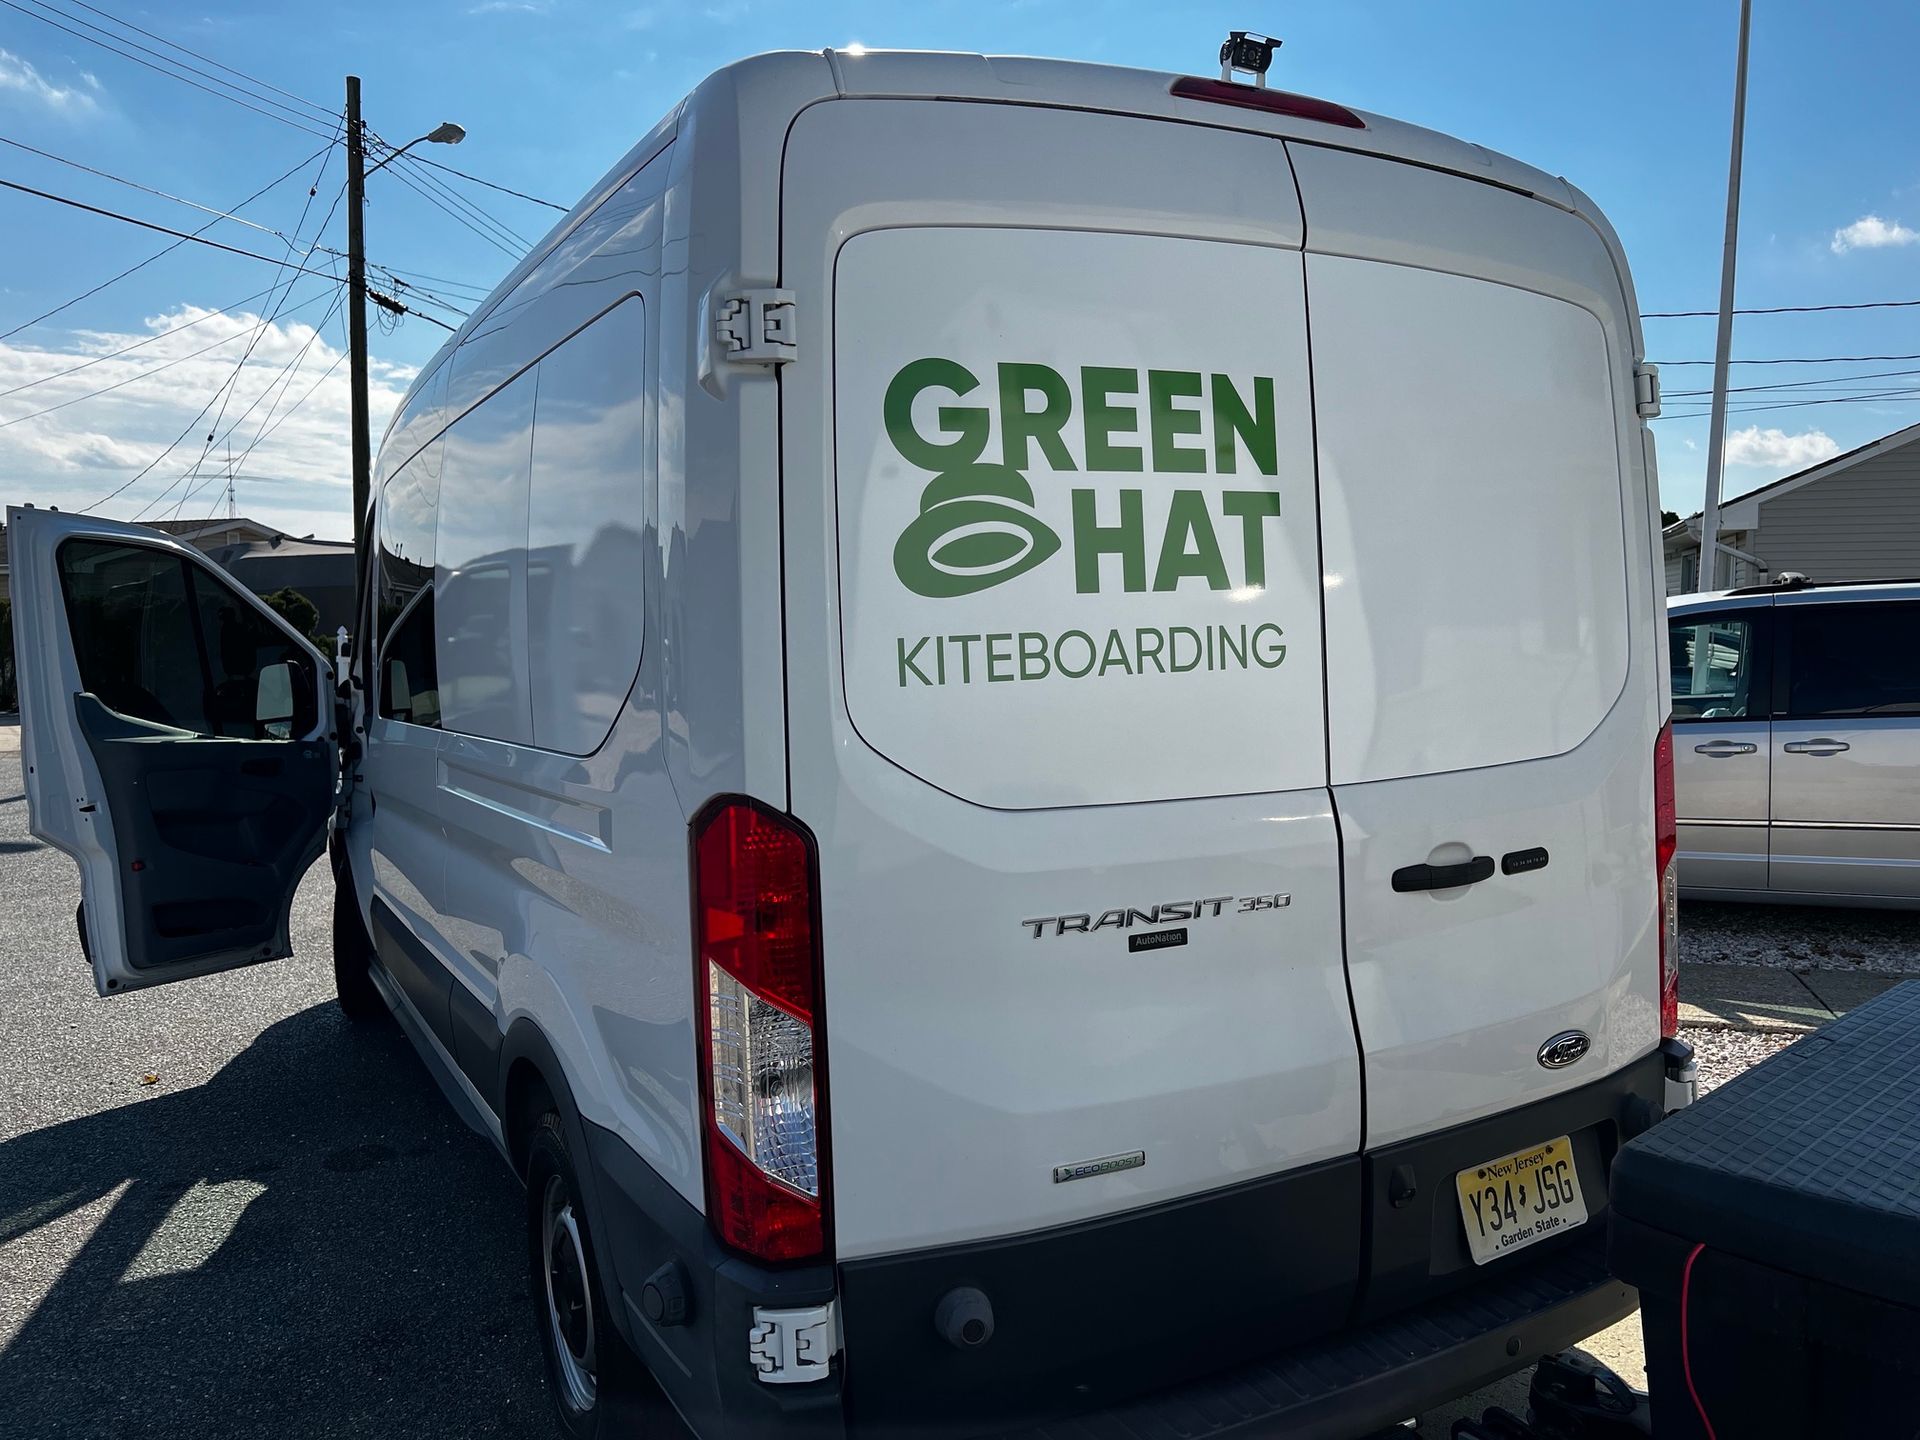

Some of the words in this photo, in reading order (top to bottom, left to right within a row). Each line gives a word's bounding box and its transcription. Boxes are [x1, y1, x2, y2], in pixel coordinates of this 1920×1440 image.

[884, 358, 1278, 476] GREEN
[1071, 488, 1281, 594] HAT
[897, 623, 1287, 688] KITEBOARDING
[1021, 896, 1234, 939] TRANSIT
[1238, 893, 1292, 914] 350
[1135, 932, 1182, 946] AutoNation
[1486, 1163, 1513, 1181] New
[1514, 1152, 1545, 1175] Jersey
[1468, 1180, 1518, 1237] Y34
[1533, 1160, 1574, 1214] JSG
[1500, 1228, 1534, 1247] Garden
[1535, 1216, 1560, 1233] State
